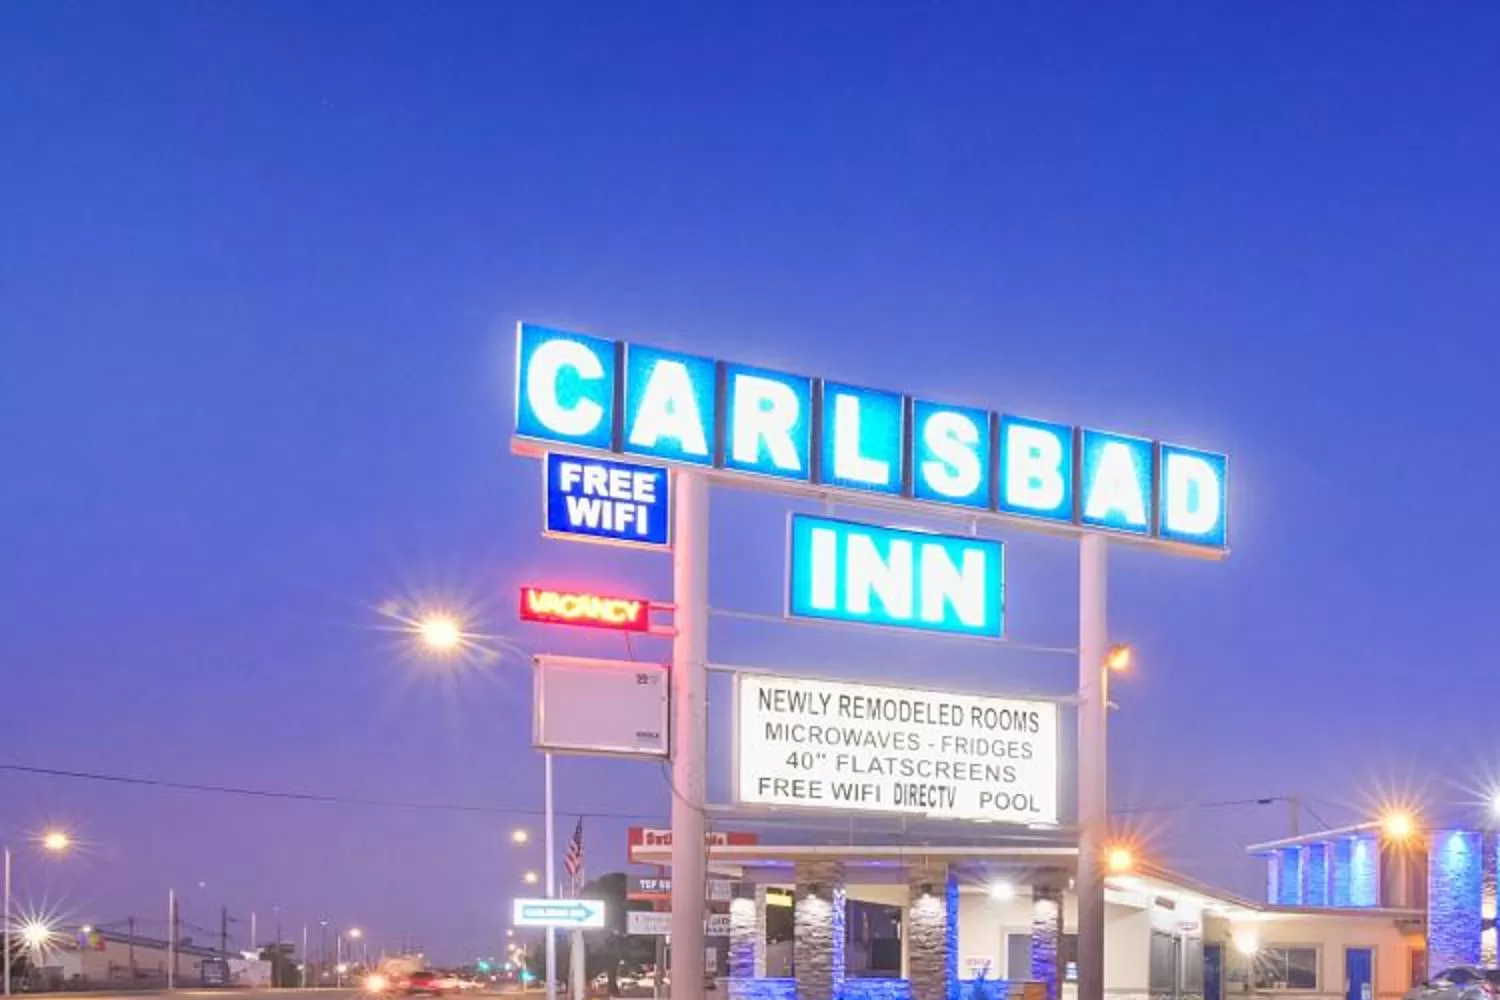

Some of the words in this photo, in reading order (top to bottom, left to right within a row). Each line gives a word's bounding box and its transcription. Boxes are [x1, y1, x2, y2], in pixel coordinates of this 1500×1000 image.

[526, 339, 1223, 535] CARLSBAD
[560, 462, 656, 503] FREE
[566, 496, 647, 535] WIFI
[808, 528, 987, 628] INN
[528, 589, 640, 623] VACANCY
[758, 687, 832, 715] NEWLY
[839, 694, 964, 727] REMODELED
[971, 706, 1040, 734] ROOMS
[765, 722, 920, 751] MICROWAVES
[941, 735, 1033, 760] FRIDGES
[836, 753, 1017, 784] FLATSCREENS
[758, 777, 823, 799] FREE
[831, 782, 881, 803] WIFI
[893, 782, 957, 809] DIRECTV
[979, 791, 1041, 813] POOL
